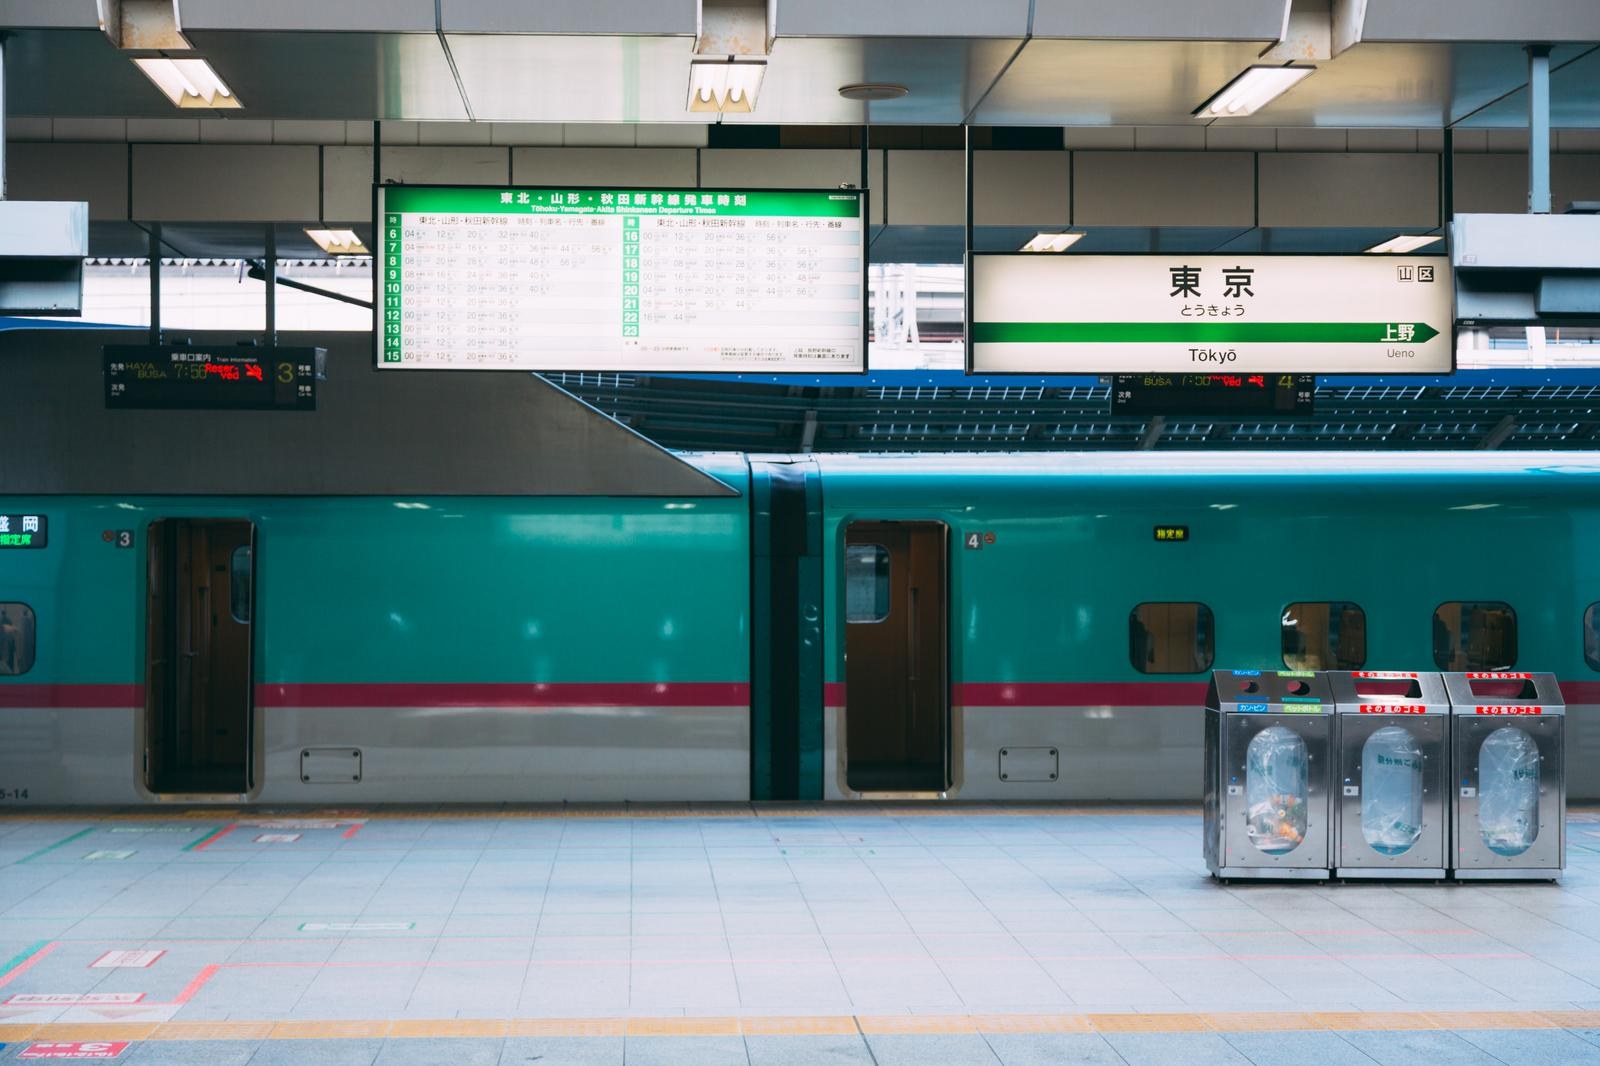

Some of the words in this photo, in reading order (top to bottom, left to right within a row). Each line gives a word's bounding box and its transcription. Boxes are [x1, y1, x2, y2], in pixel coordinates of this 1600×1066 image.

[616, 206, 657, 214] Shinkansen
[658, 207, 694, 215] Departure
[389, 230, 396, 239] 6
[624, 232, 637, 241] 16
[389, 243, 396, 252] 7
[624, 245, 637, 254] 17
[389, 257, 396, 266] 8
[624, 259, 637, 268] 18
[389, 270, 396, 279] 9
[624, 272, 637, 281] 19
[1169, 265, 1255, 299] 東京
[387, 284, 399, 293] 10
[624, 286, 637, 295] 20
[387, 298, 399, 307] 11
[624, 299, 637, 308] 21
[1180, 303, 1246, 318] とうきょう
[387, 311, 399, 320] 12
[624, 313, 637, 322] 22
[387, 325, 399, 334] 13
[624, 327, 637, 335] 23
[1380, 324, 1416, 343] 上野
[387, 338, 399, 347] 14
[387, 352, 399, 361] 15
[1188, 347, 1238, 364] Tōkyō
[1387, 348, 1415, 358] Ueno
[277, 363, 293, 383] 3
[1144, 378, 1172, 386] BUSA
[1278, 376, 1294, 389] 4
[120, 531, 130, 546] 3
[968, 534, 979, 548] 4
